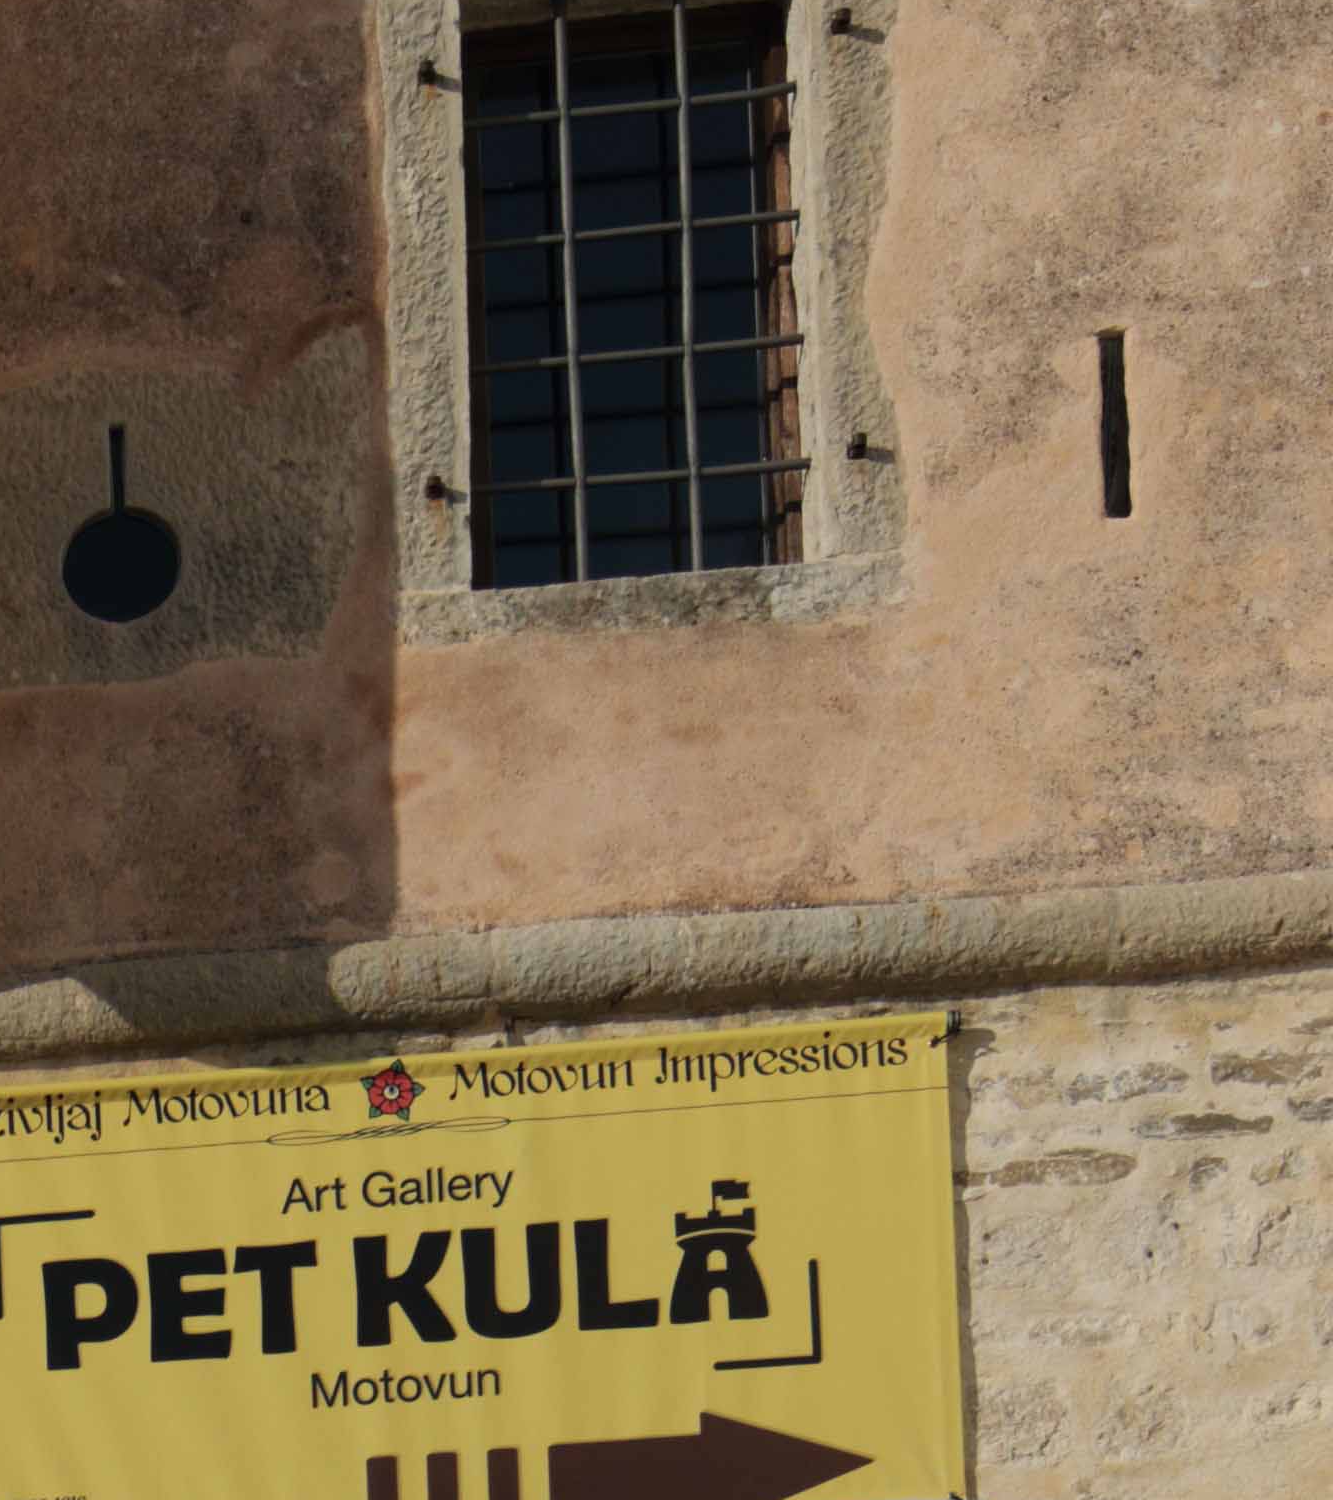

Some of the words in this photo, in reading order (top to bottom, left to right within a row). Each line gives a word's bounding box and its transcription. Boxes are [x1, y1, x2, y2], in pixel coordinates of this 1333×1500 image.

[449, 1057, 633, 1101] Motovun
[655, 1031, 908, 1092] Impressions
[123, 1084, 330, 1127] Motovuna
[281, 1177, 346, 1214] Art
[361, 1167, 513, 1209] Gallery
[41, 1240, 318, 1370] PET
[352, 1186, 769, 1348] KULA
[311, 1368, 501, 1409] Motovun
